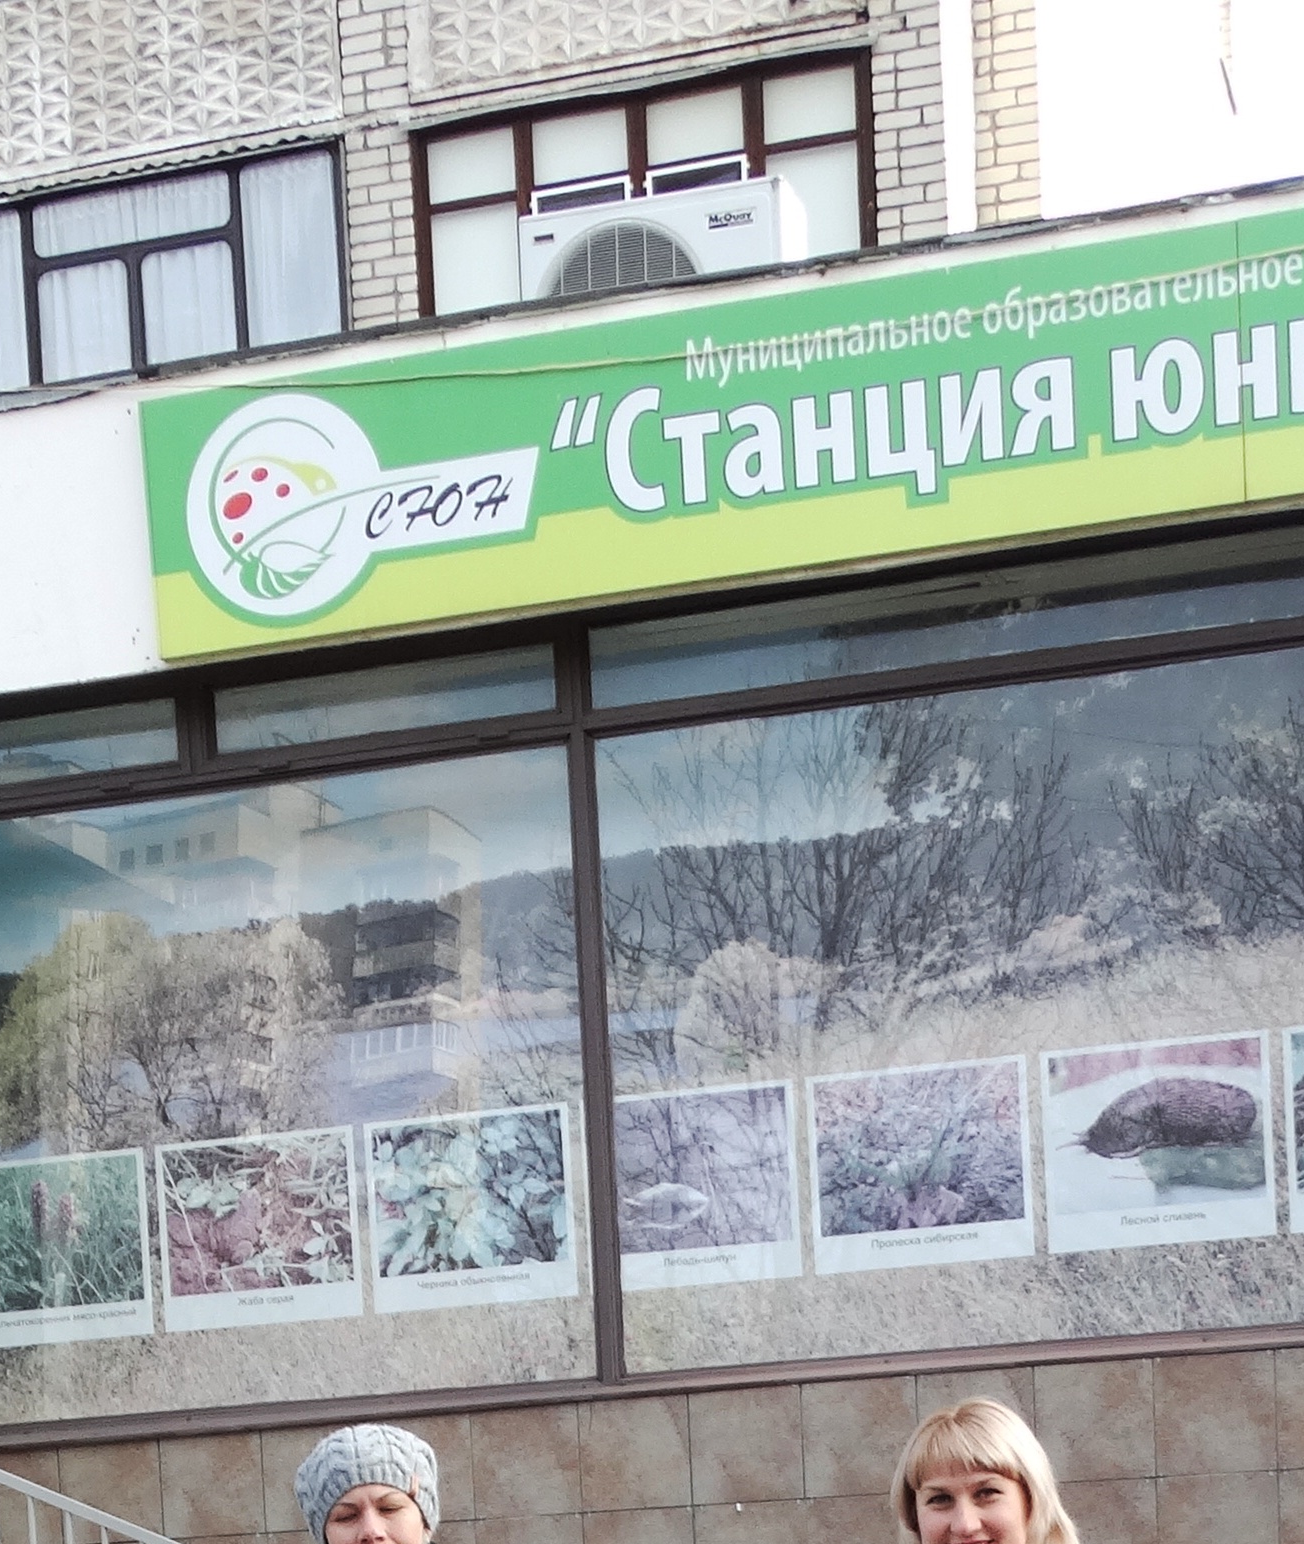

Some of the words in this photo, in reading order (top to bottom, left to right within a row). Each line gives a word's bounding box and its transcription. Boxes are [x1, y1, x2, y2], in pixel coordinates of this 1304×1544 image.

[684, 307, 972, 387] Муниципальное
[982, 252, 1303, 341] образовательное
[364, 474, 514, 540] СЮН
[870, 1237, 921, 1250] Пролеска
